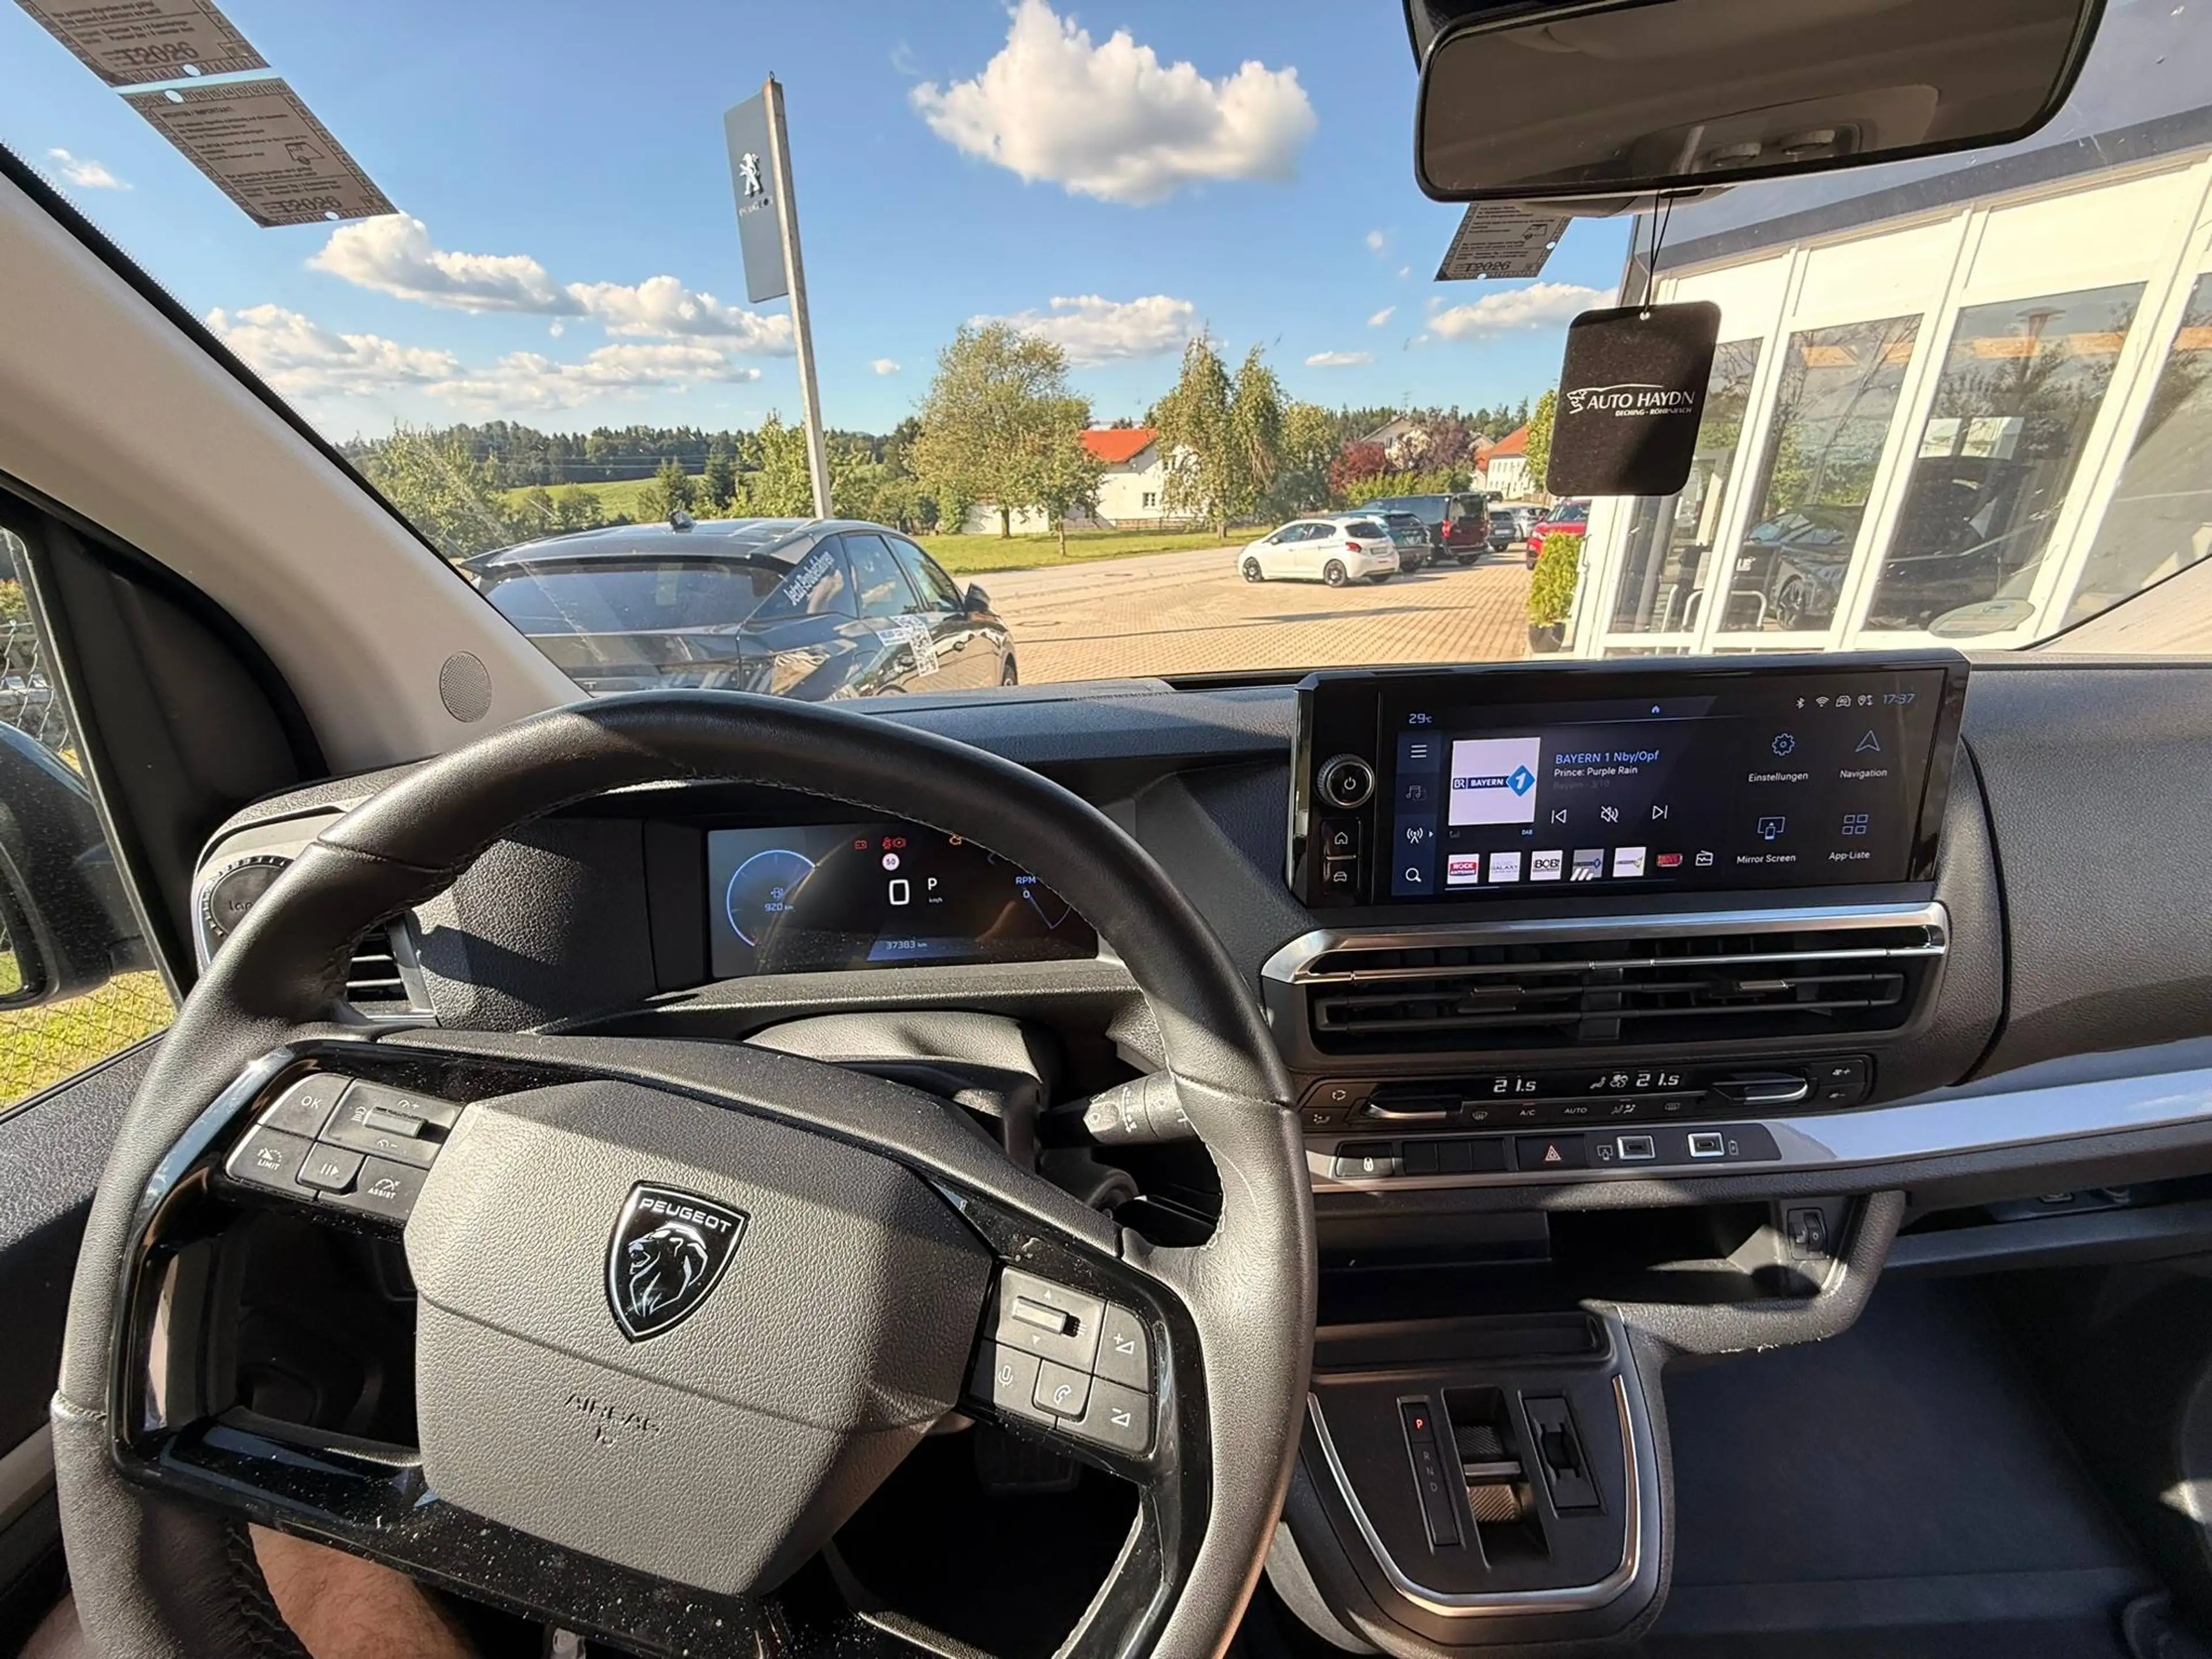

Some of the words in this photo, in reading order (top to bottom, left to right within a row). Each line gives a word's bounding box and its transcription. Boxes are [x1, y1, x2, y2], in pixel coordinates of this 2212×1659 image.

[1586, 393, 1633, 410] AUTO
[1637, 391, 1696, 407] HAYDN
[1556, 753, 1601, 764] BAYERN
[1605, 752, 1611, 763] 1
[1613, 749, 1660, 764] Nby/Opf
[1554, 767, 1585, 777] Prince:
[1586, 767, 1616, 777] Purple
[1618, 765, 1638, 775] Rain
[1840, 769, 1888, 780] Navigation
[1454, 778, 1466, 789] BR
[1471, 778, 1504, 787] BAYERN
[1515, 772, 1527, 790] 1
[1748, 772, 1809, 783] Einstellungen
[1737, 855, 1763, 864] Mirror
[1766, 854, 1797, 863] Screen
[1828, 851, 1871, 862] App-Liste
[927, 877, 938, 891] P
[1016, 876, 1036, 885] RPM
[889, 879, 910, 906] 0
[764, 902, 783, 912] 920
[885, 940, 915, 949] 37383
[1493, 1076, 1537, 1093] 21.5
[1636, 1070, 1680, 1087] 21.5
[301, 1096, 322, 1109] OK
[1565, 1107, 1588, 1115] AUTO
[257, 1160, 281, 1171] LIMIT
[367, 1187, 396, 1199] ASSIST
[638, 1198, 732, 1233] PEUGEOT
[1416, 1419, 1423, 1429] P
